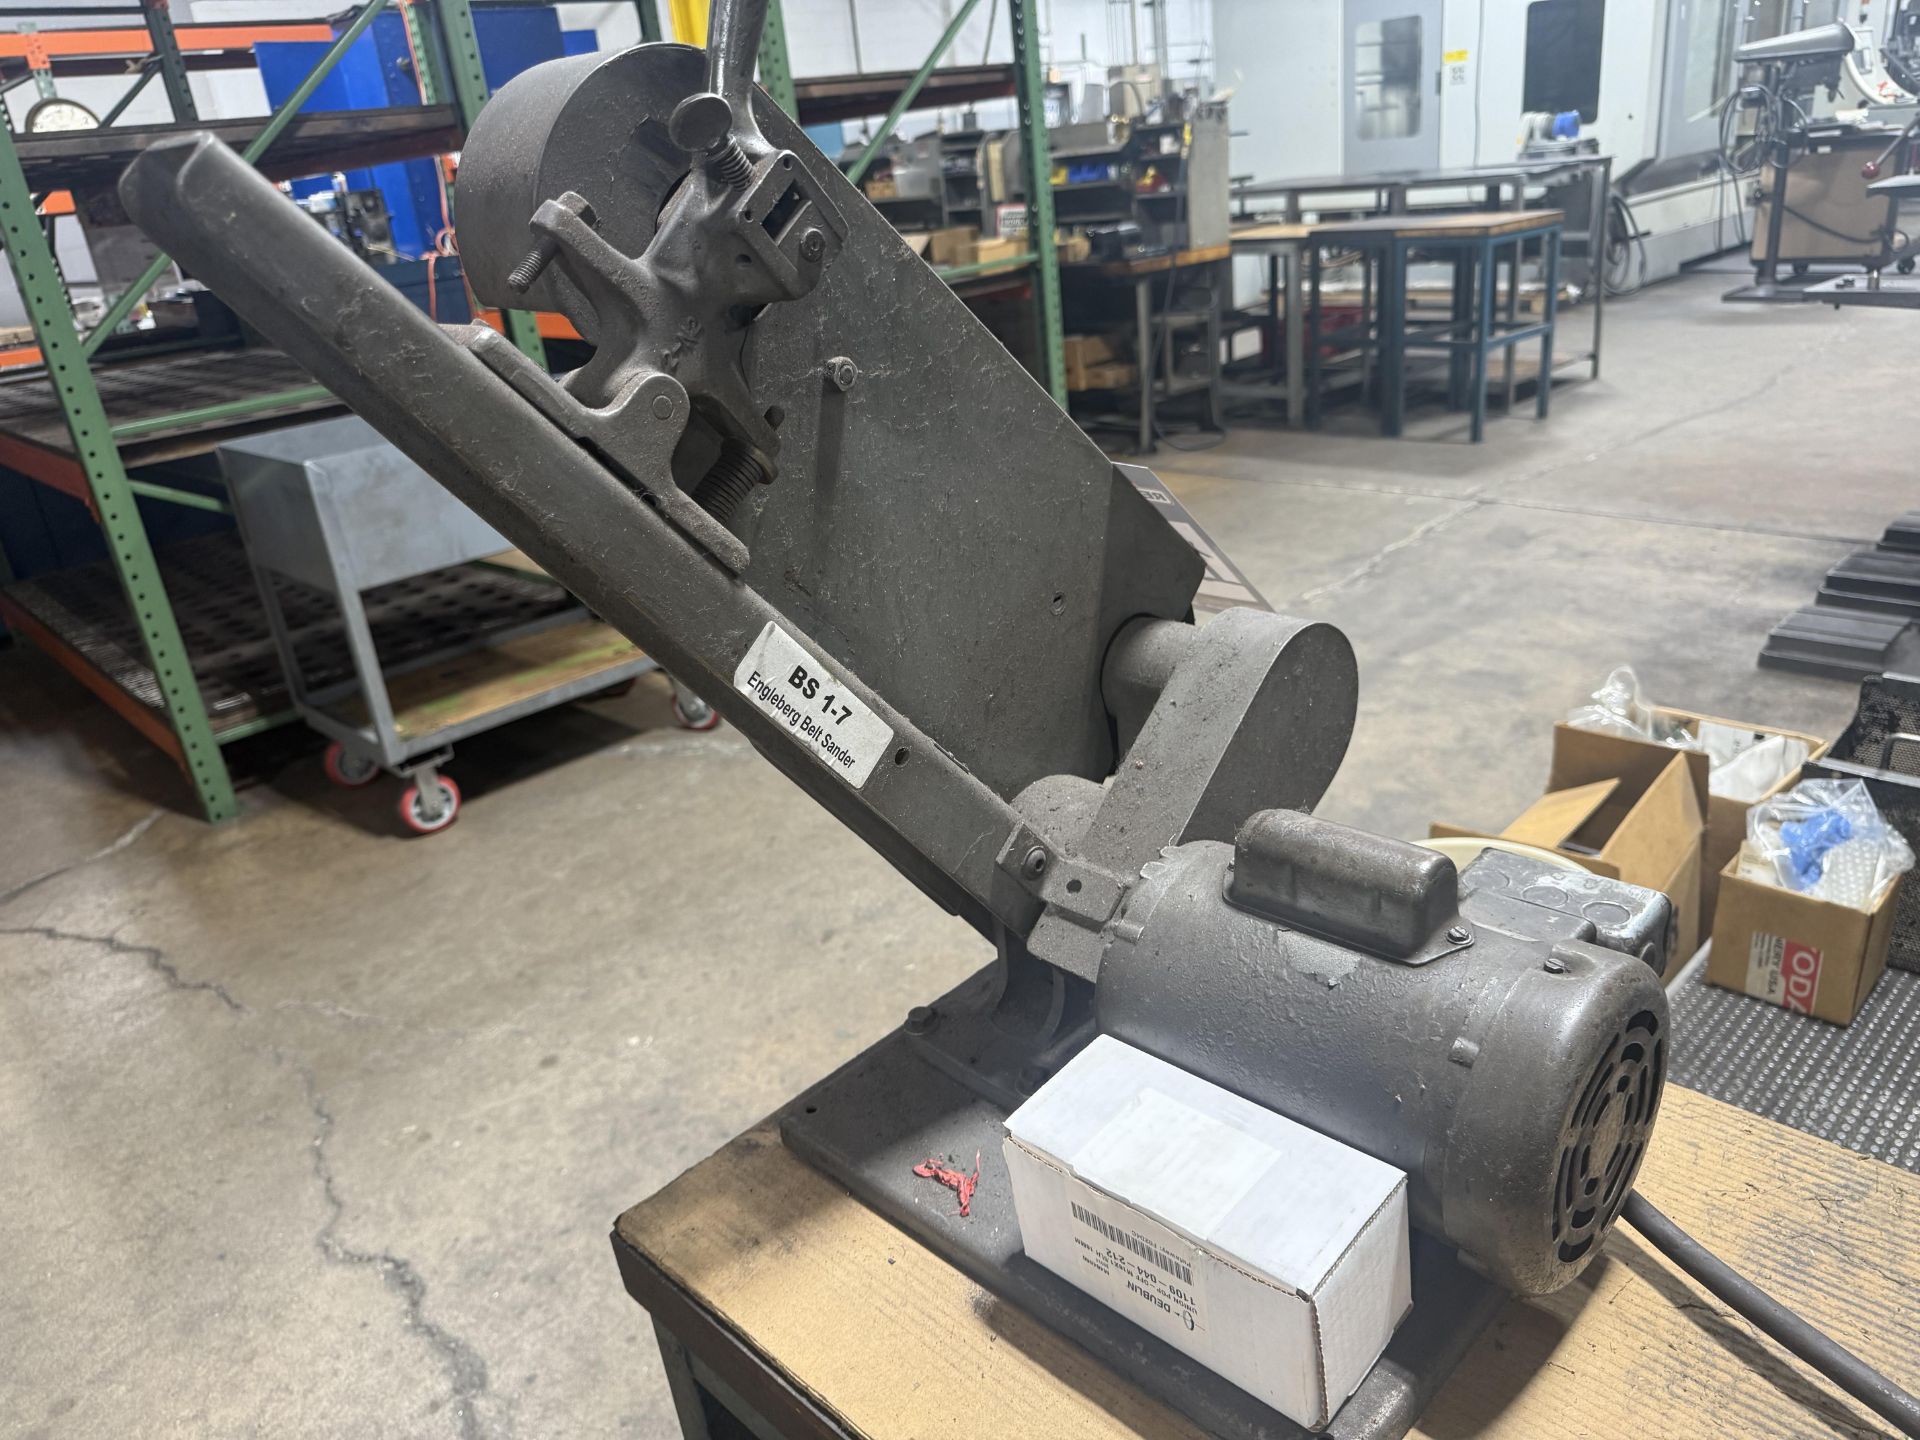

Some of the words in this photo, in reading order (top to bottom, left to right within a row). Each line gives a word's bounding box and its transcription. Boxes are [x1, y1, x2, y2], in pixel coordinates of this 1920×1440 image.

[747, 671, 801, 727] Engleberg
[800, 715, 824, 742] Belt
[821, 733, 856, 769] Sander
[788, 665, 820, 699] BS
[821, 694, 853, 726] 1-7
[1787, 947, 1816, 1014] ODA
[1127, 1280, 1171, 1313] DEUBLIN
